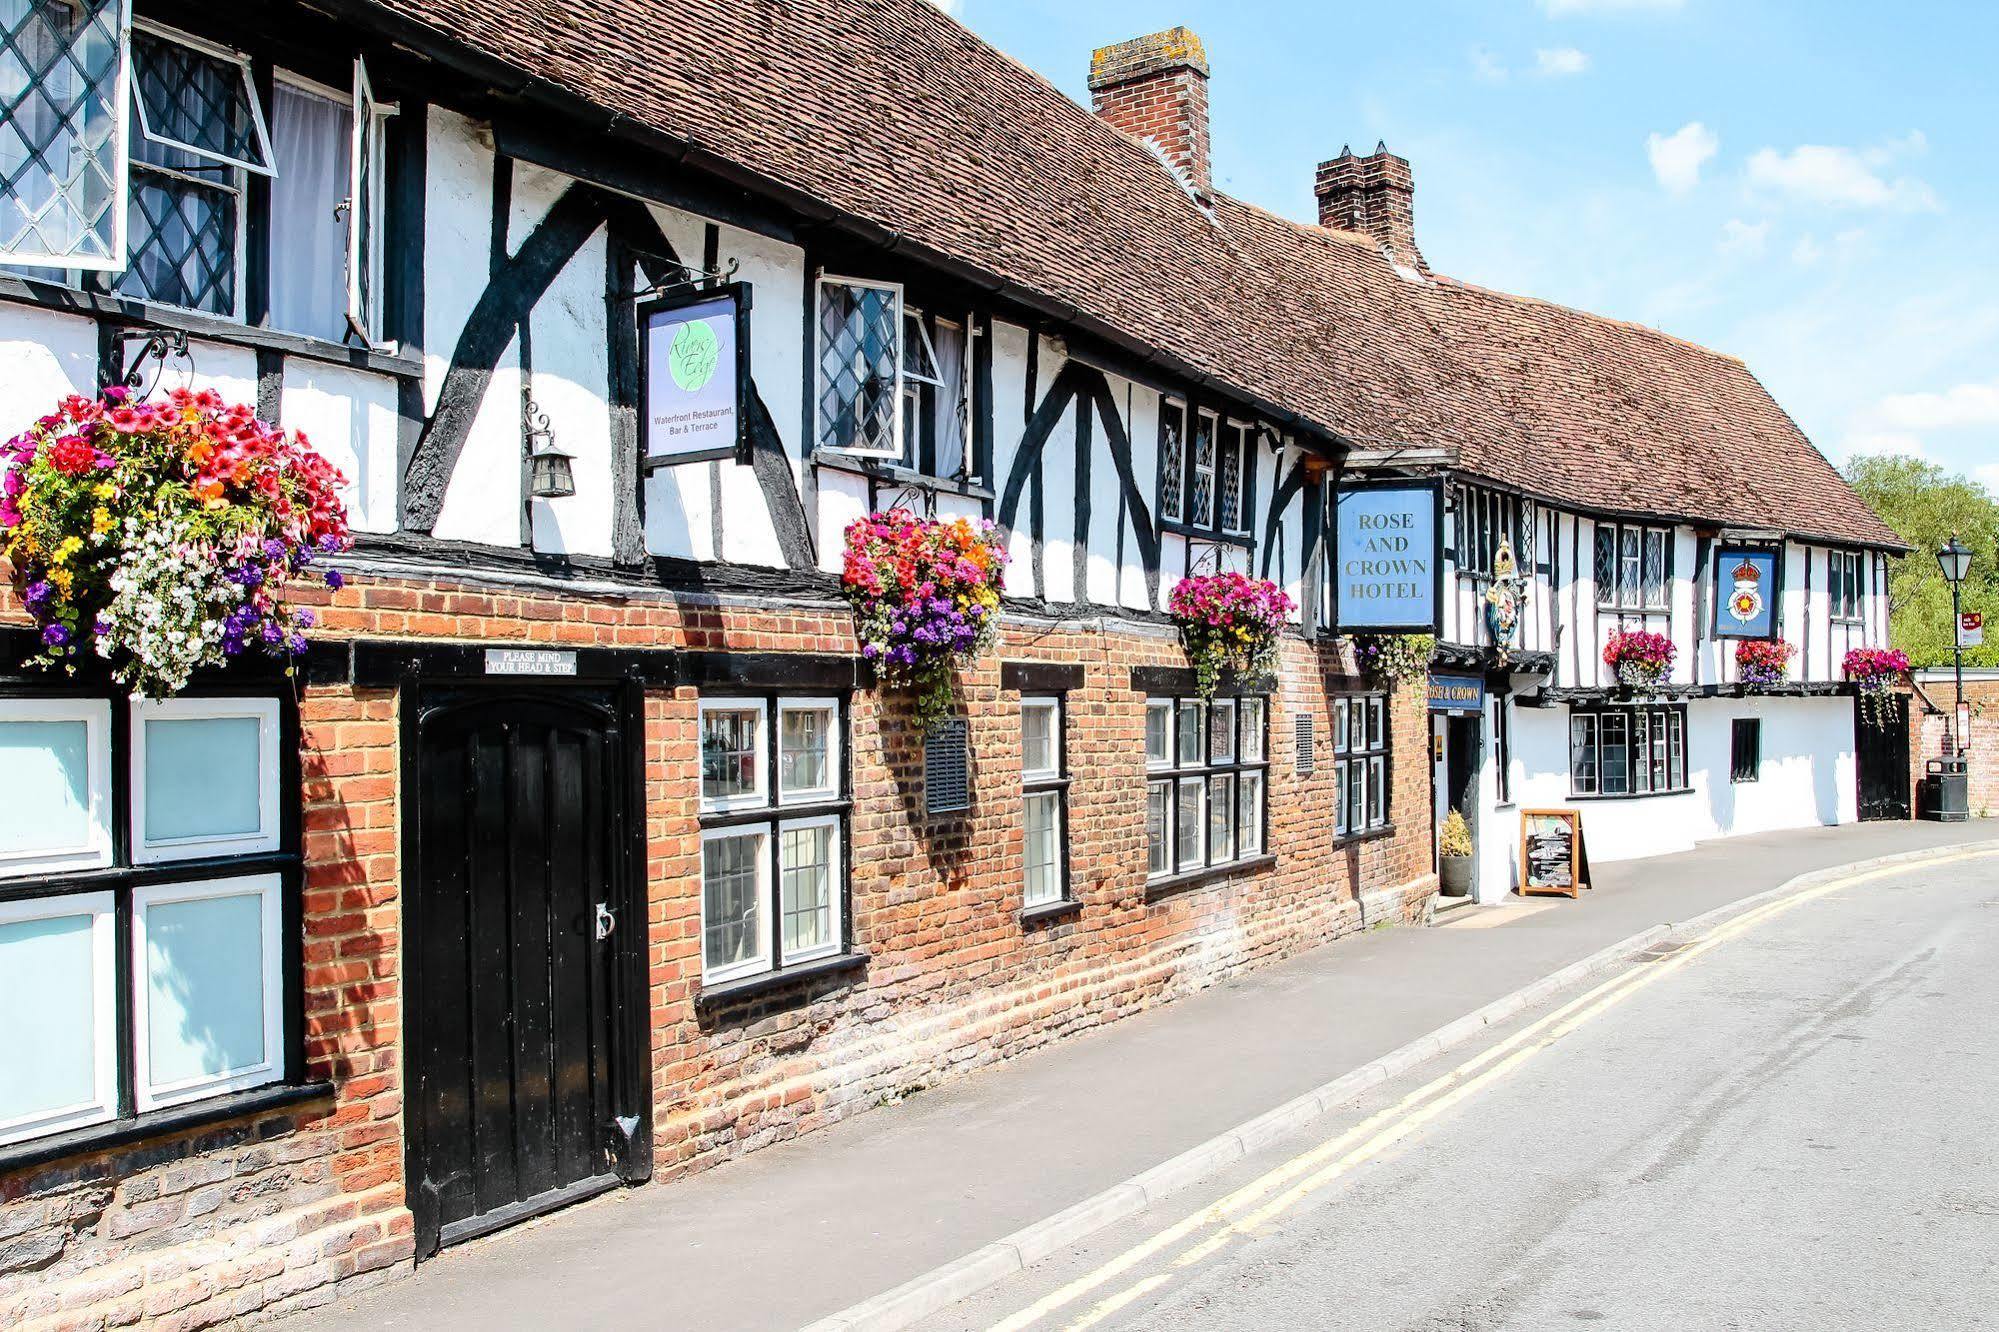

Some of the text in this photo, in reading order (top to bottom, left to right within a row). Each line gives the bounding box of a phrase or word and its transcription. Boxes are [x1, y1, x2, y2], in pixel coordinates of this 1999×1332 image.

[654, 412, 692, 426] Waterfront
[669, 421, 718, 436] Bar & Terrace
[1359, 513, 1414, 530] ROSE
[1364, 536, 1408, 552] AND
[1345, 559, 1426, 576] CROWN
[1350, 583, 1423, 599] HOTEL
[503, 652, 561, 663] PLEASE MIND
[490, 662, 573, 673] YOUR HEAD & STEP
[1451, 687, 1479, 700] CROWN
